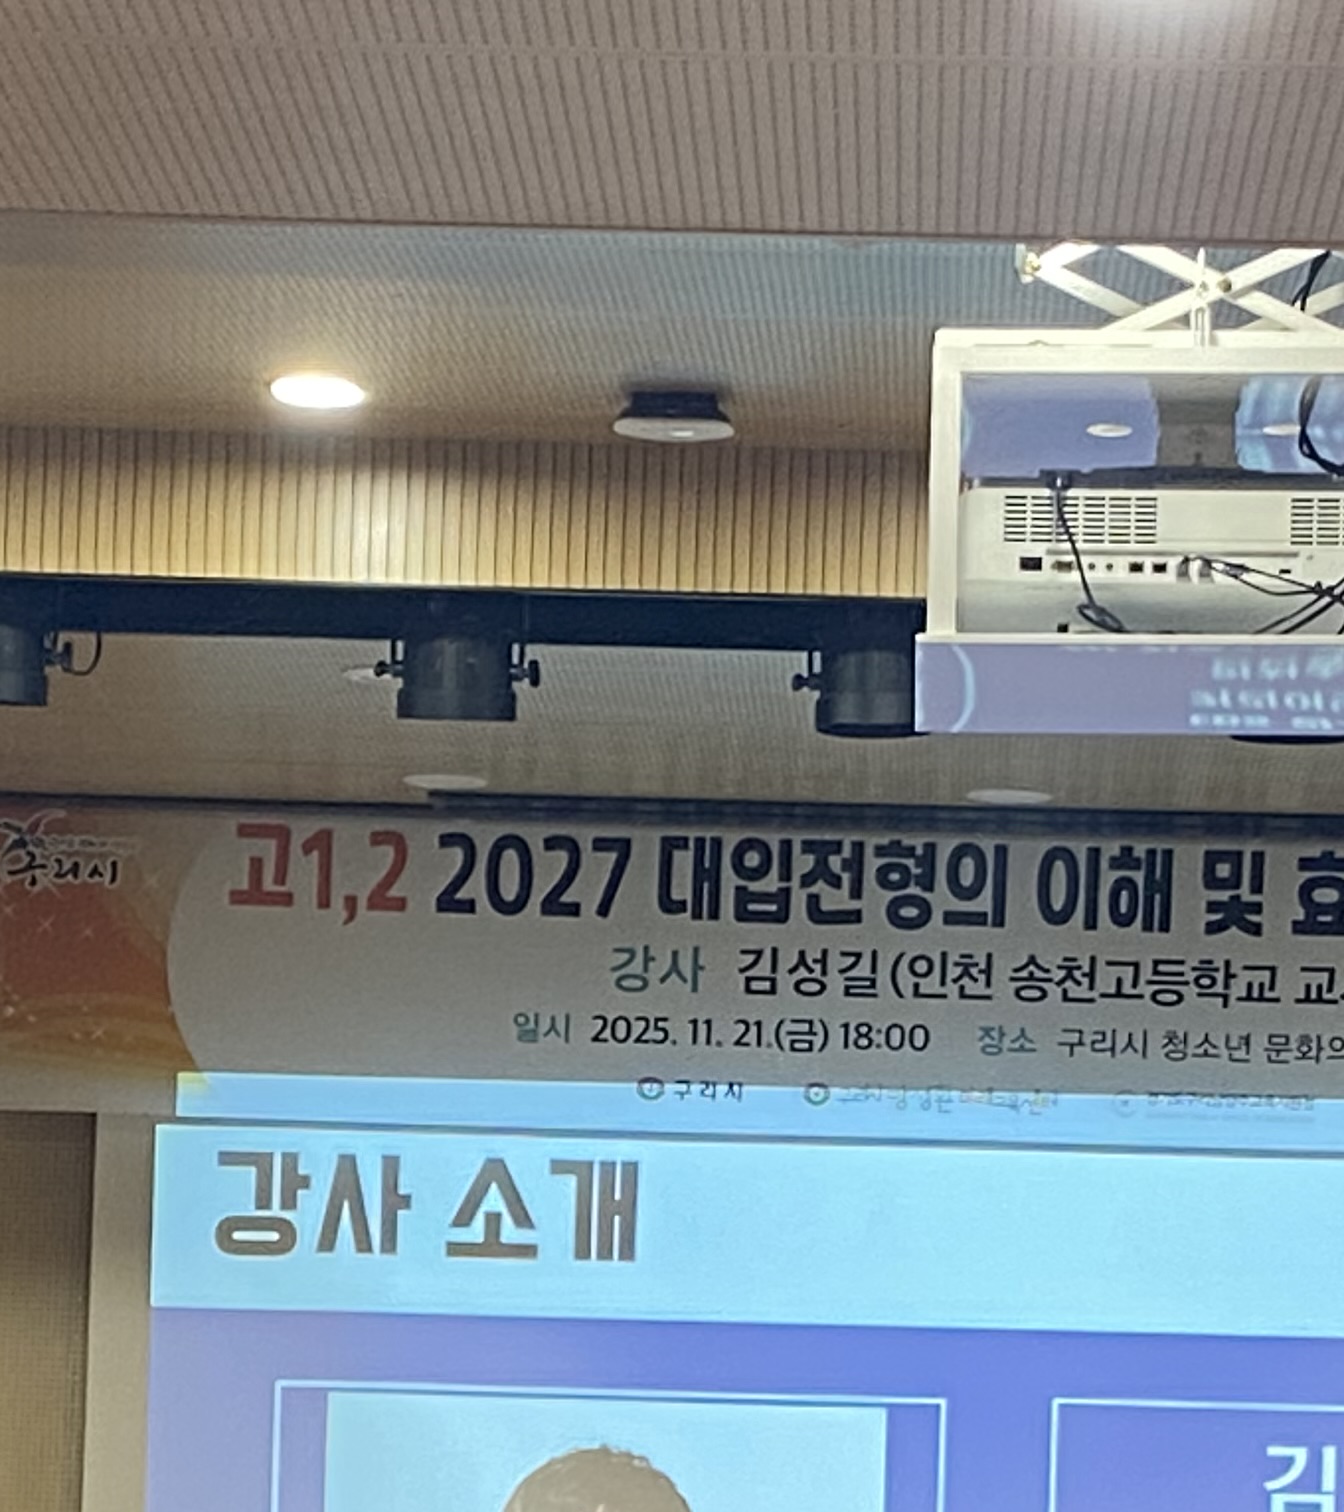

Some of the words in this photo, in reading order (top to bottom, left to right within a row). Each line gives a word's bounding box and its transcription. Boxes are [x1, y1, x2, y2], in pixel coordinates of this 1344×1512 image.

[6, 850, 118, 887] 구리시
[228, 821, 408, 925] 고1,2
[435, 833, 633, 918] 2027
[658, 835, 1010, 929] 대입전형의
[1037, 845, 1174, 934] 이해
[1202, 848, 1265, 937] 및
[609, 945, 706, 993] 강사
[737, 947, 995, 1000] 김성길(인천
[1009, 956, 1281, 1007] 송천고등학교
[512, 1011, 572, 1044] 일시
[840, 1022, 930, 1053] 18:00
[976, 1025, 1037, 1057] 장소
[1057, 1027, 1150, 1061] 구리시
[1161, 1028, 1253, 1064] 청소년
[673, 1081, 744, 1102] 구리시
[214, 1150, 412, 1256] 강사
[445, 1157, 639, 1262] 소개
